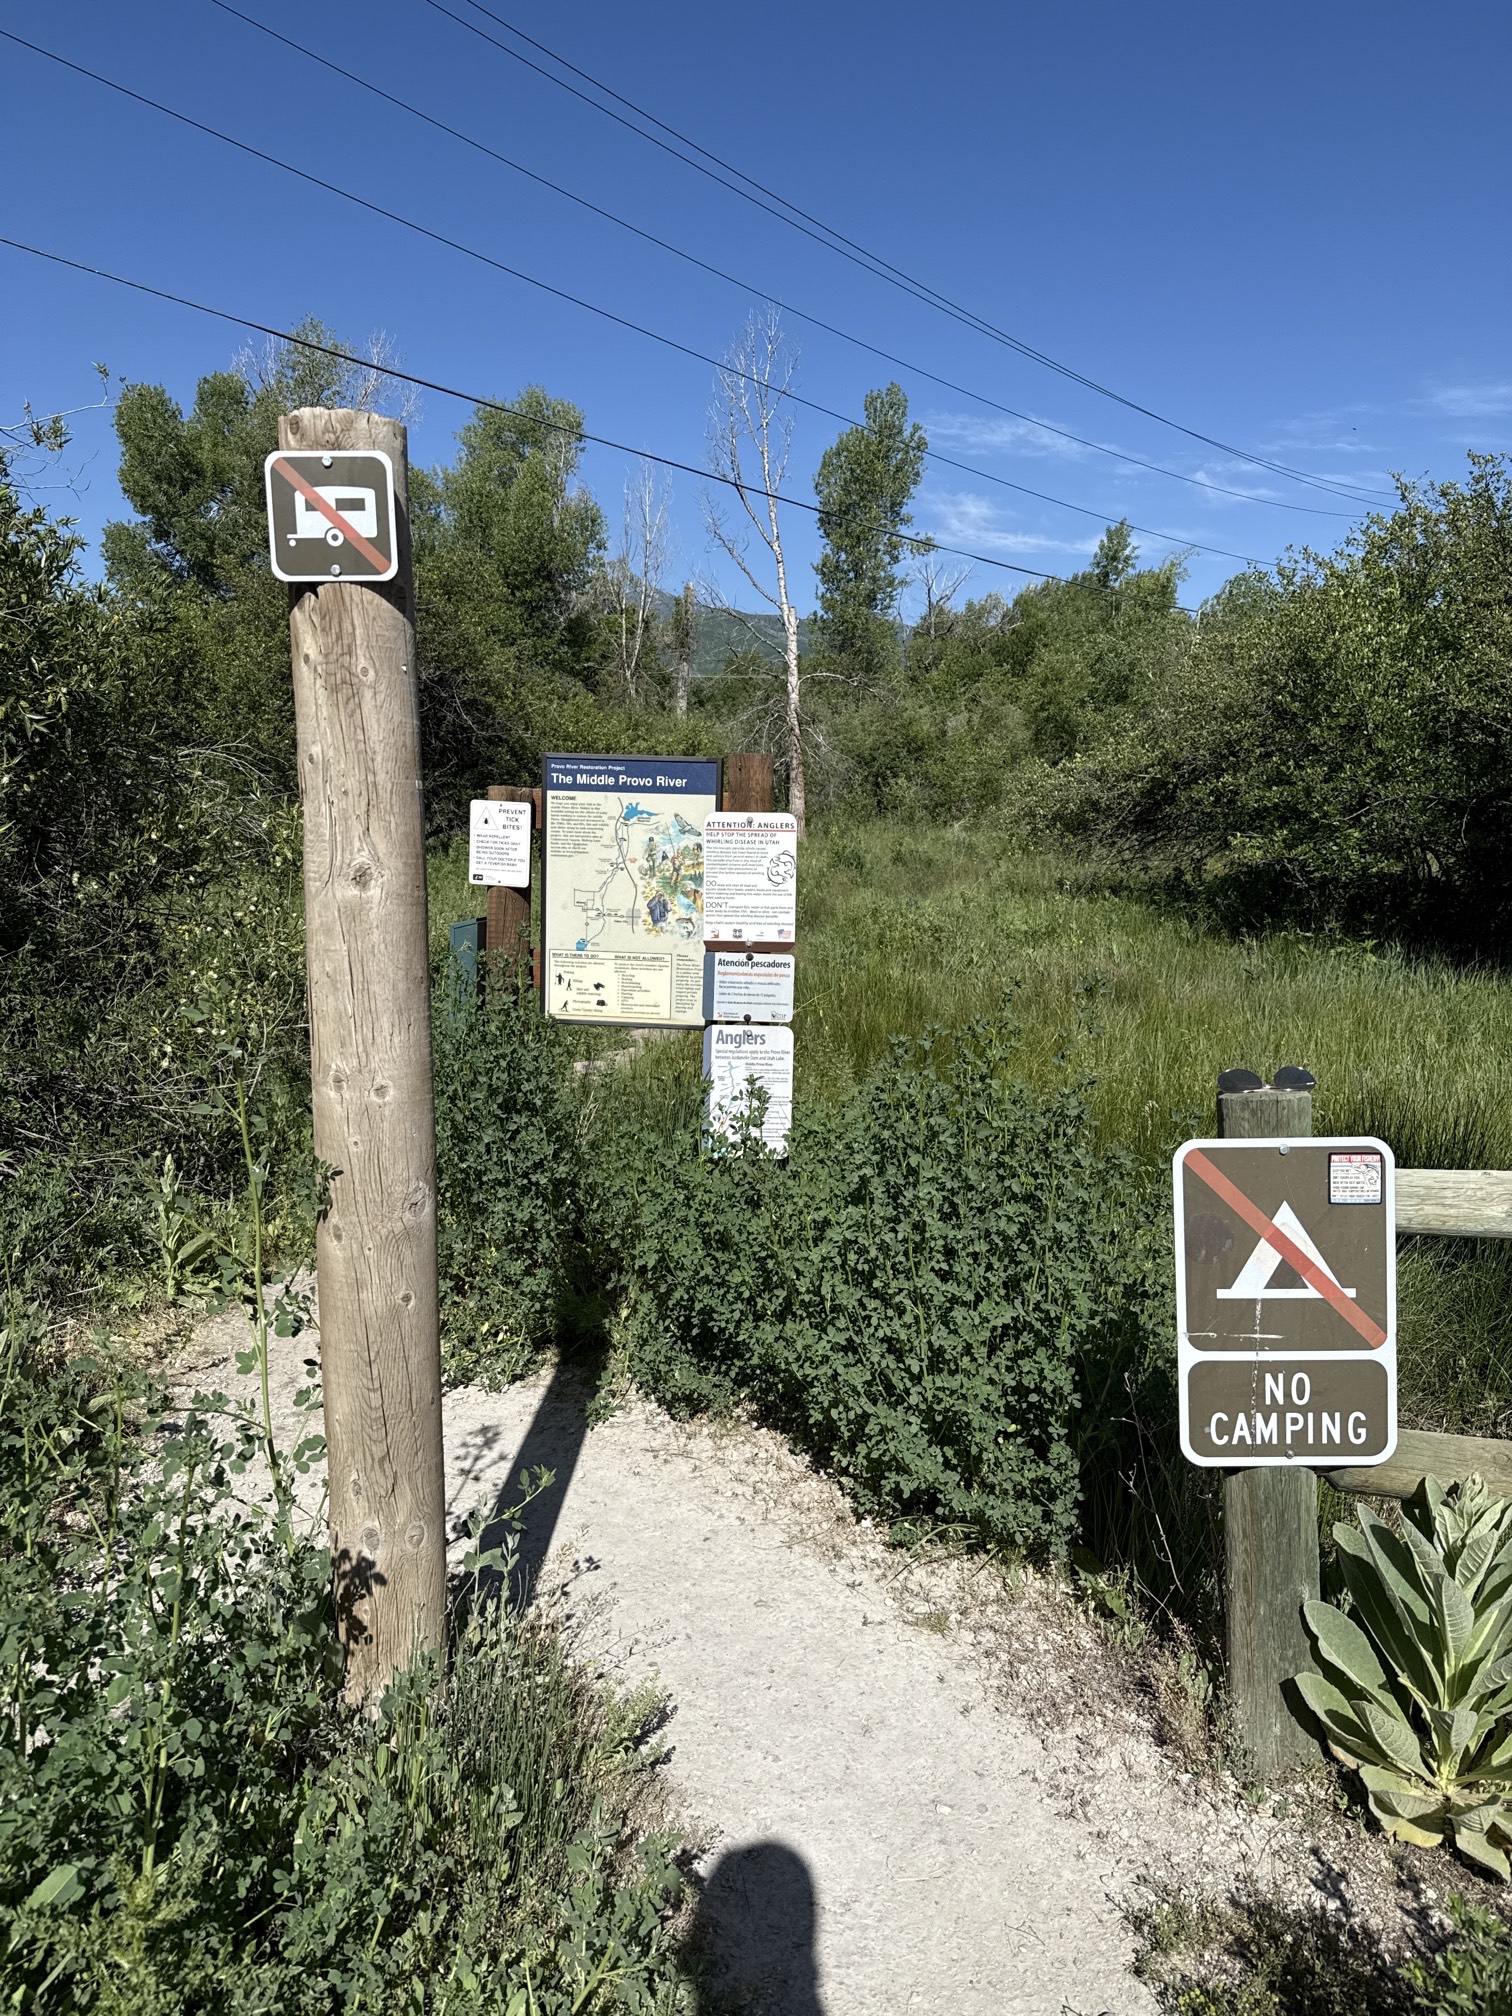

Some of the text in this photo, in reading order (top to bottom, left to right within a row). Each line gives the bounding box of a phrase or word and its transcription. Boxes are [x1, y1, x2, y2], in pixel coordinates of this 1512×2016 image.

[551, 773, 687, 787] The Middle Provo River
[718, 958, 791, 969] Atención pescadores
[716, 1029, 766, 1048] Anglers
[1331, 1155, 1350, 1163] PROTECT
[1351, 1155, 1361, 1163] YOUR
[1264, 1372, 1311, 1405] NO
[1210, 1411, 1367, 1445] CAMPING
